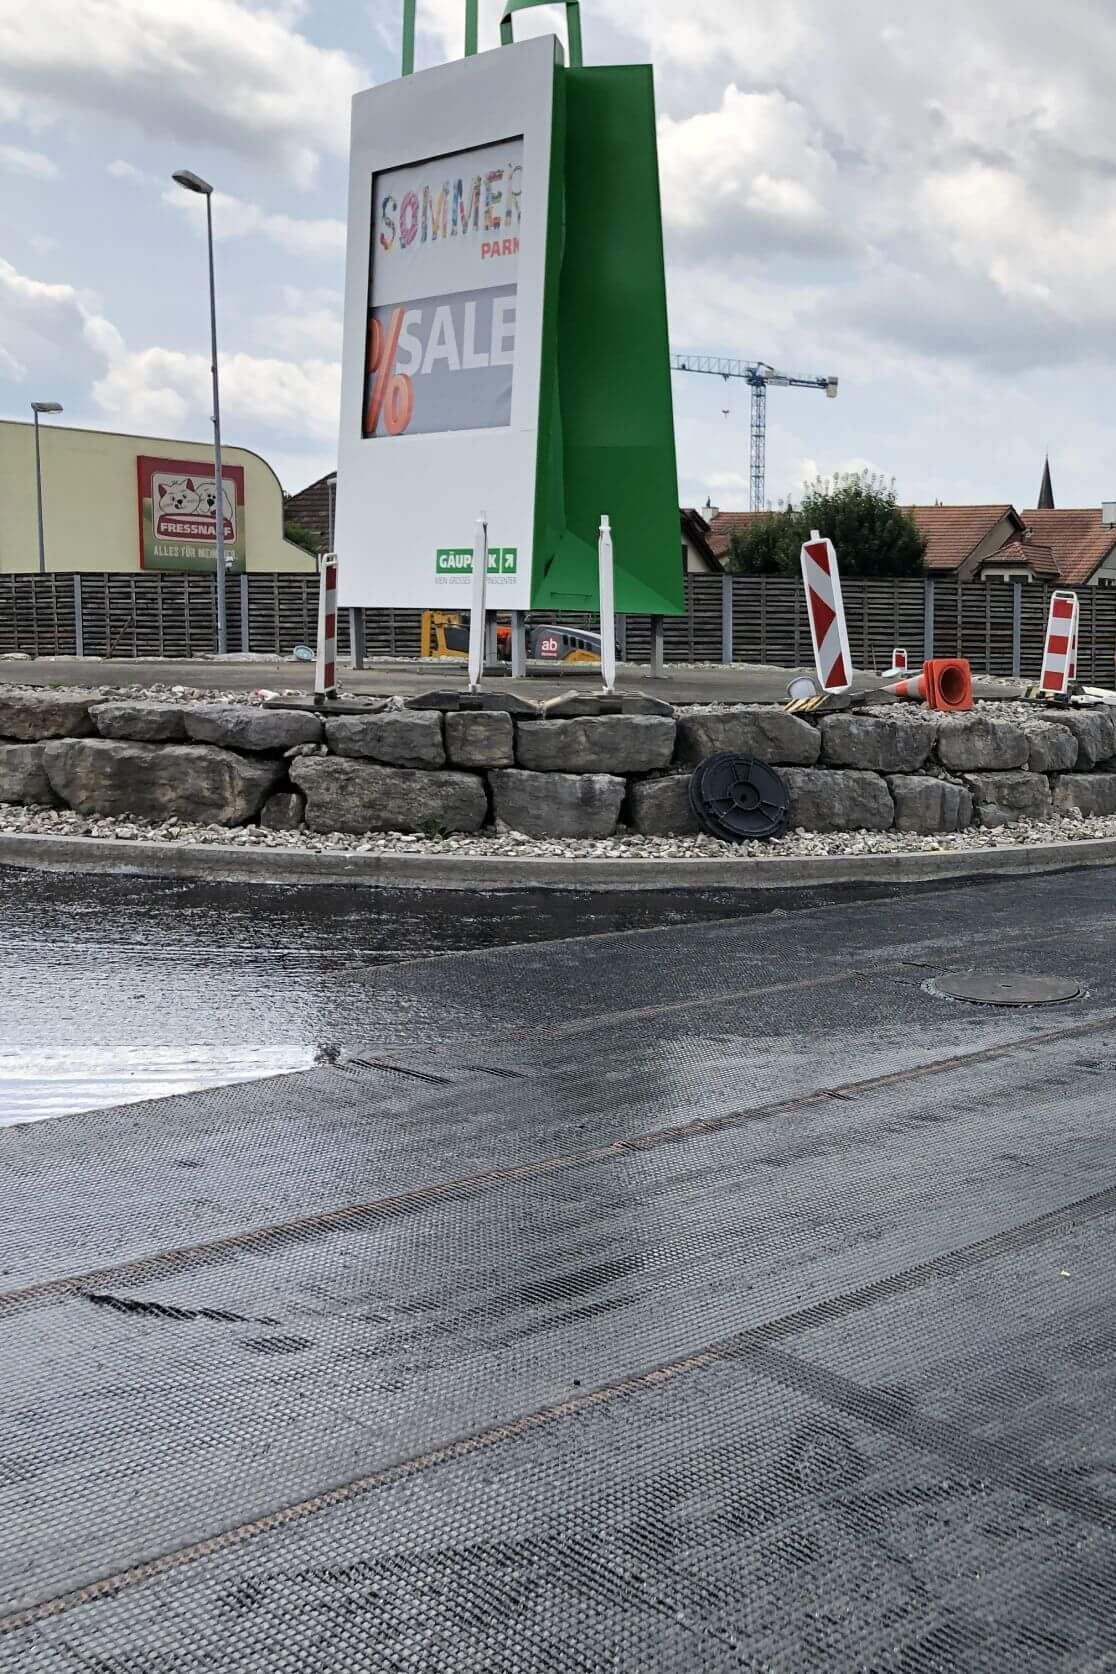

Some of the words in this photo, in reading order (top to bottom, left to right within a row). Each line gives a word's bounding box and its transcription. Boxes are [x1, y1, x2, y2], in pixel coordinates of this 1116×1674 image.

[379, 161, 523, 255] SOMMER
[395, 295, 517, 376] SALE
[160, 522, 232, 536] FRESSNAF
[154, 545, 179, 557] ALLES
[439, 551, 497, 569] GÄUPK
[541, 638, 558, 651] ab
